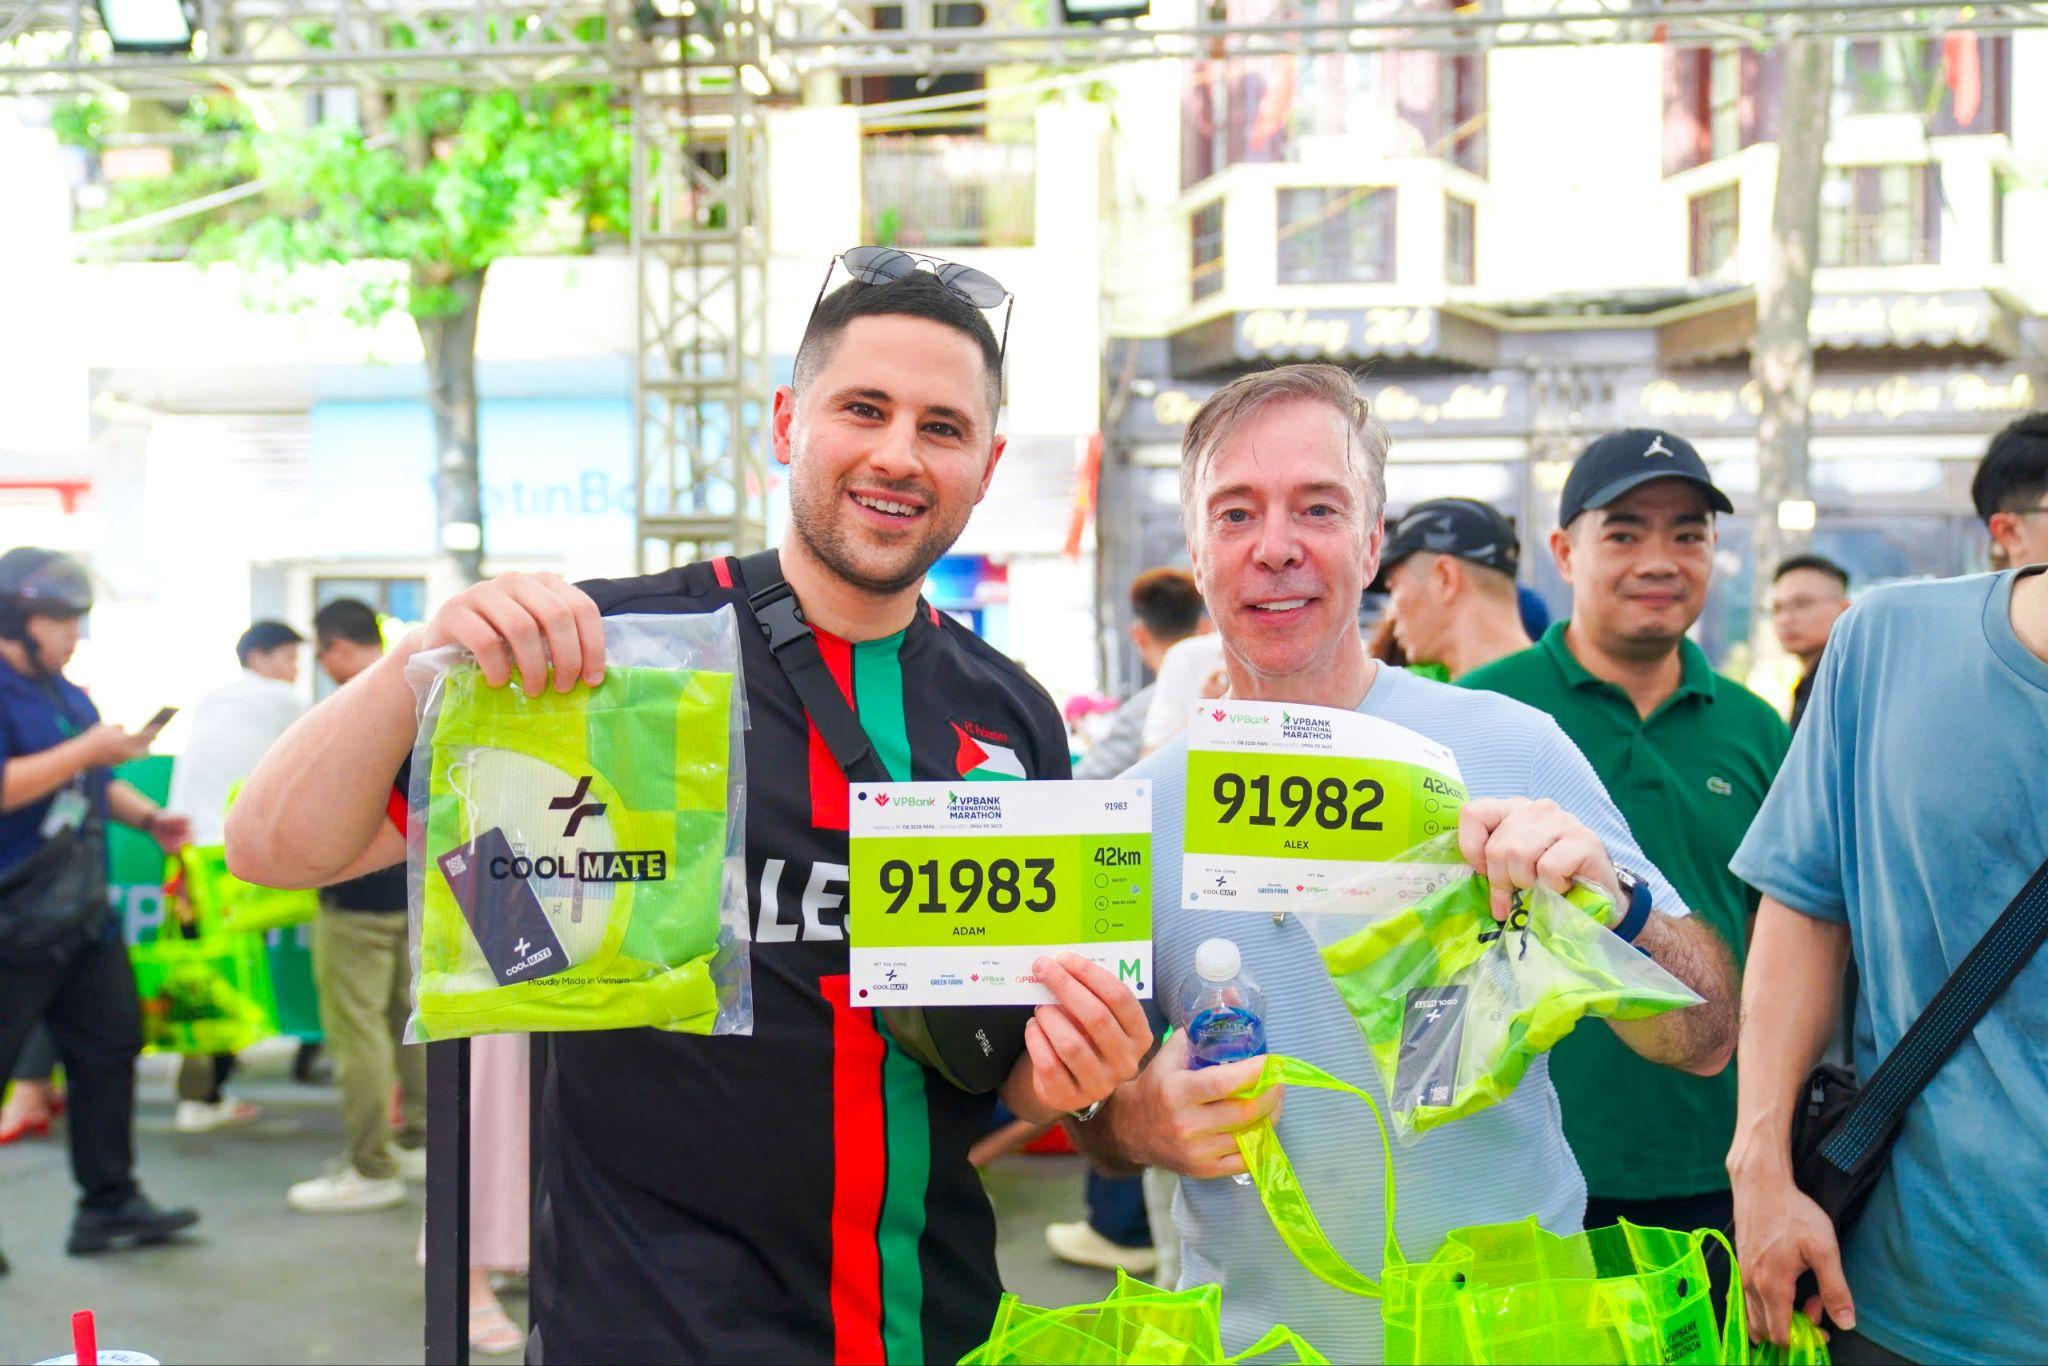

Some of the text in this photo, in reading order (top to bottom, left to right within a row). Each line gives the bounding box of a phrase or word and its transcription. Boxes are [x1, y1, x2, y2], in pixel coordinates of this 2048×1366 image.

[1229, 714, 1270, 724] VPBank
[1293, 717, 1330, 727] VPBANK
[1283, 725, 1331, 733] INTERNATIONAL
[1283, 731, 1332, 740] MARATHON
[1423, 777, 1464, 801] 42km
[893, 797, 935, 807] VPBank
[959, 796, 1000, 805] VPBANK
[1213, 772, 1384, 831] 91982
[1104, 802, 1128, 811] 91983
[950, 811, 1001, 819] MARATHON
[1284, 840, 1309, 850] ALEX
[1094, 847, 1141, 866] 42km
[879, 858, 1056, 914] 91983
[952, 926, 986, 936] ADAM
[1119, 958, 1141, 982] M
[528, 977, 560, 986] Proudly
[562, 977, 586, 985] Made
[596, 976, 630, 984] Vietnam
